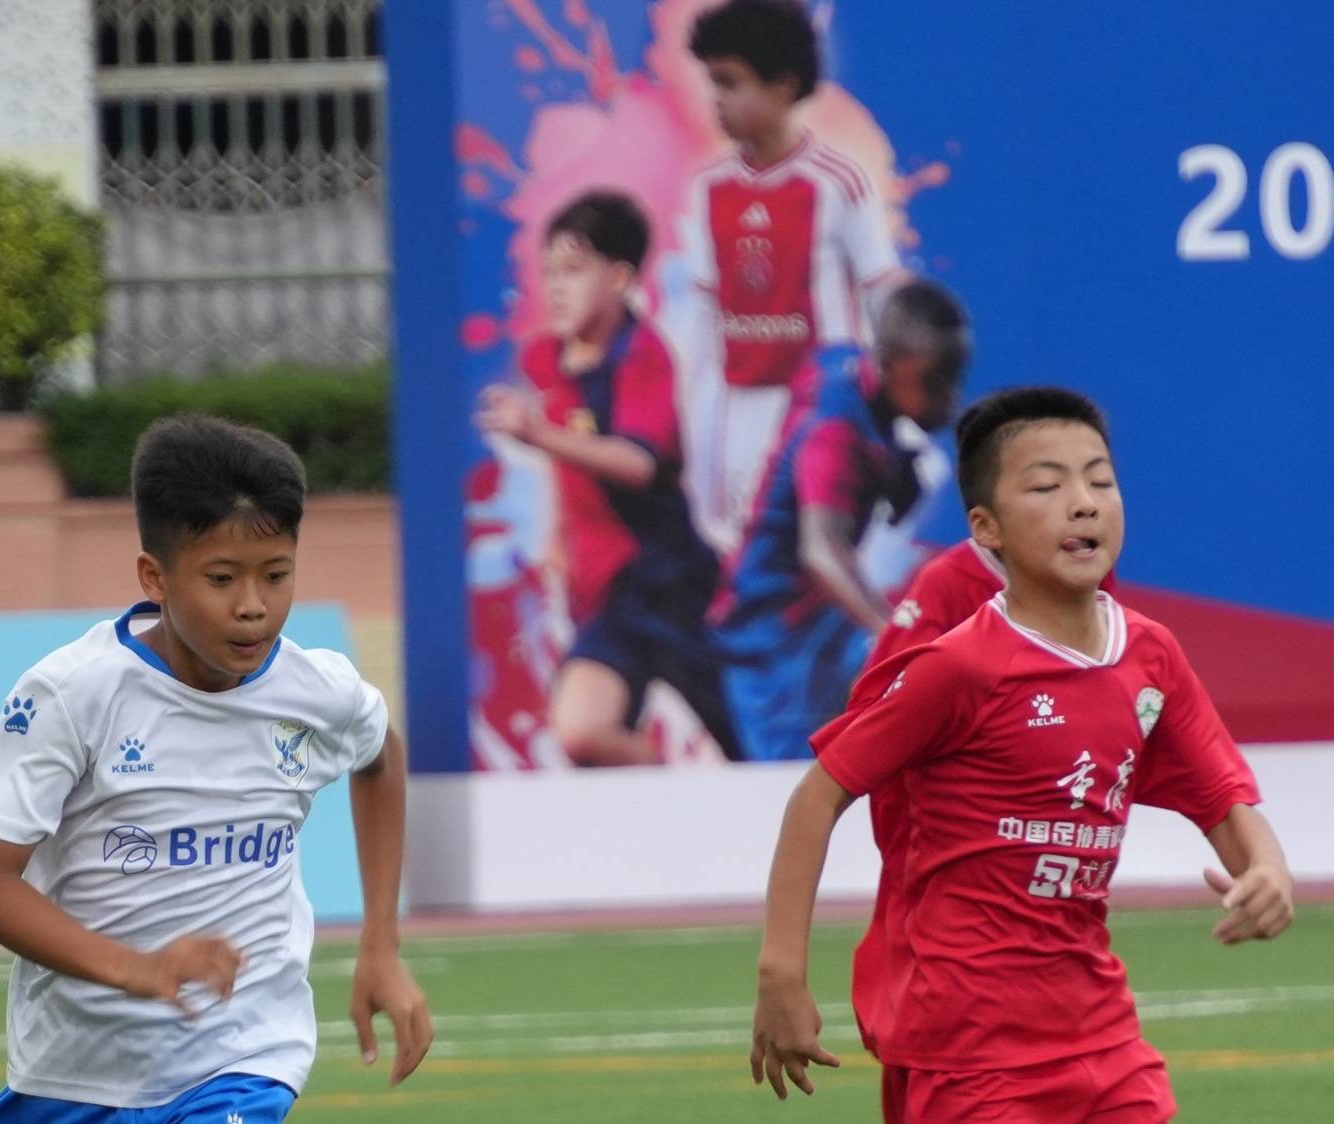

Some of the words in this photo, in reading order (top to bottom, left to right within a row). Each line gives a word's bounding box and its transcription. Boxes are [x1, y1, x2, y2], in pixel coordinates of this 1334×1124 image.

[1028, 715, 1066, 728] KELME
[112, 763, 156, 774] KELME
[168, 822, 296, 869] Bridge
